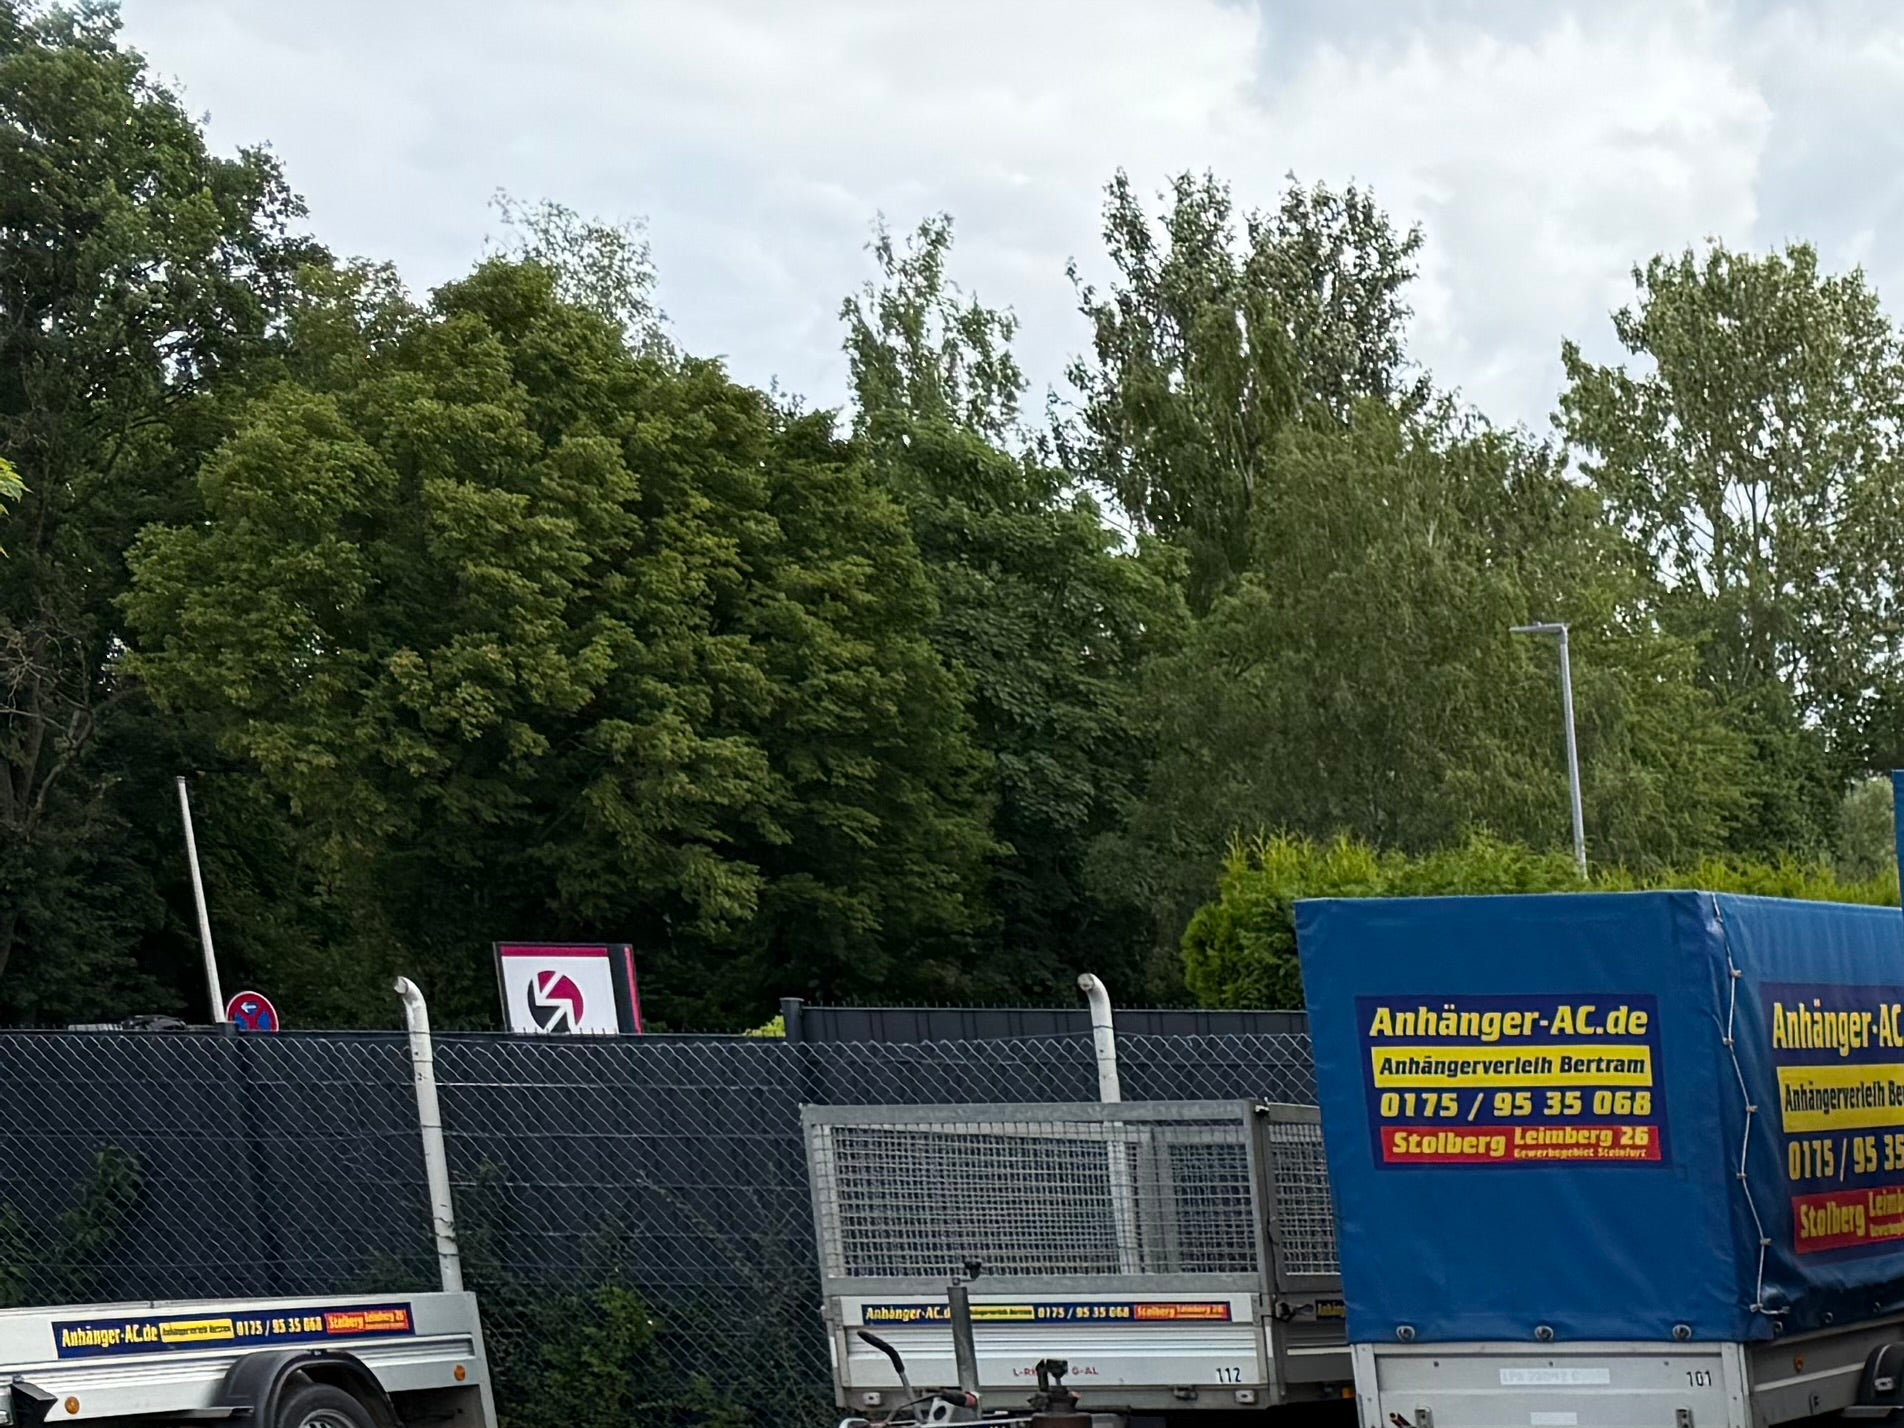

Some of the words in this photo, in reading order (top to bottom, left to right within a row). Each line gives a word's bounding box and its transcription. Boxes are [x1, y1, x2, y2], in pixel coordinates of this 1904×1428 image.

[1369, 1004, 1649, 1042] Anhänger-AC.de
[1380, 1055, 1552, 1078] Anhängerverleih
[1559, 1055, 1645, 1074] Bertram
[1380, 1092, 1458, 1118] 0175
[1467, 1092, 1484, 1121] /
[1493, 1092, 1532, 1117] 95
[1543, 1090, 1582, 1116] 35
[1593, 1090, 1652, 1116] 068
[1392, 1132, 1506, 1157] Stolberg
[1514, 1126, 1613, 1147] Leimberg
[1620, 1126, 1649, 1146] 26
[1788, 1139, 1835, 1181] 0175
[1840, 1137, 1848, 1182] /
[1853, 1135, 1878, 1174] 95
[1800, 1201, 1865, 1239] Stolberg
[865, 1306, 950, 1322] Anhänger-AC.d
[62, 1321, 158, 1348] Anhänger-AC.de
[1215, 1368, 1242, 1384] 112
[1686, 1370, 1712, 1388] 101
